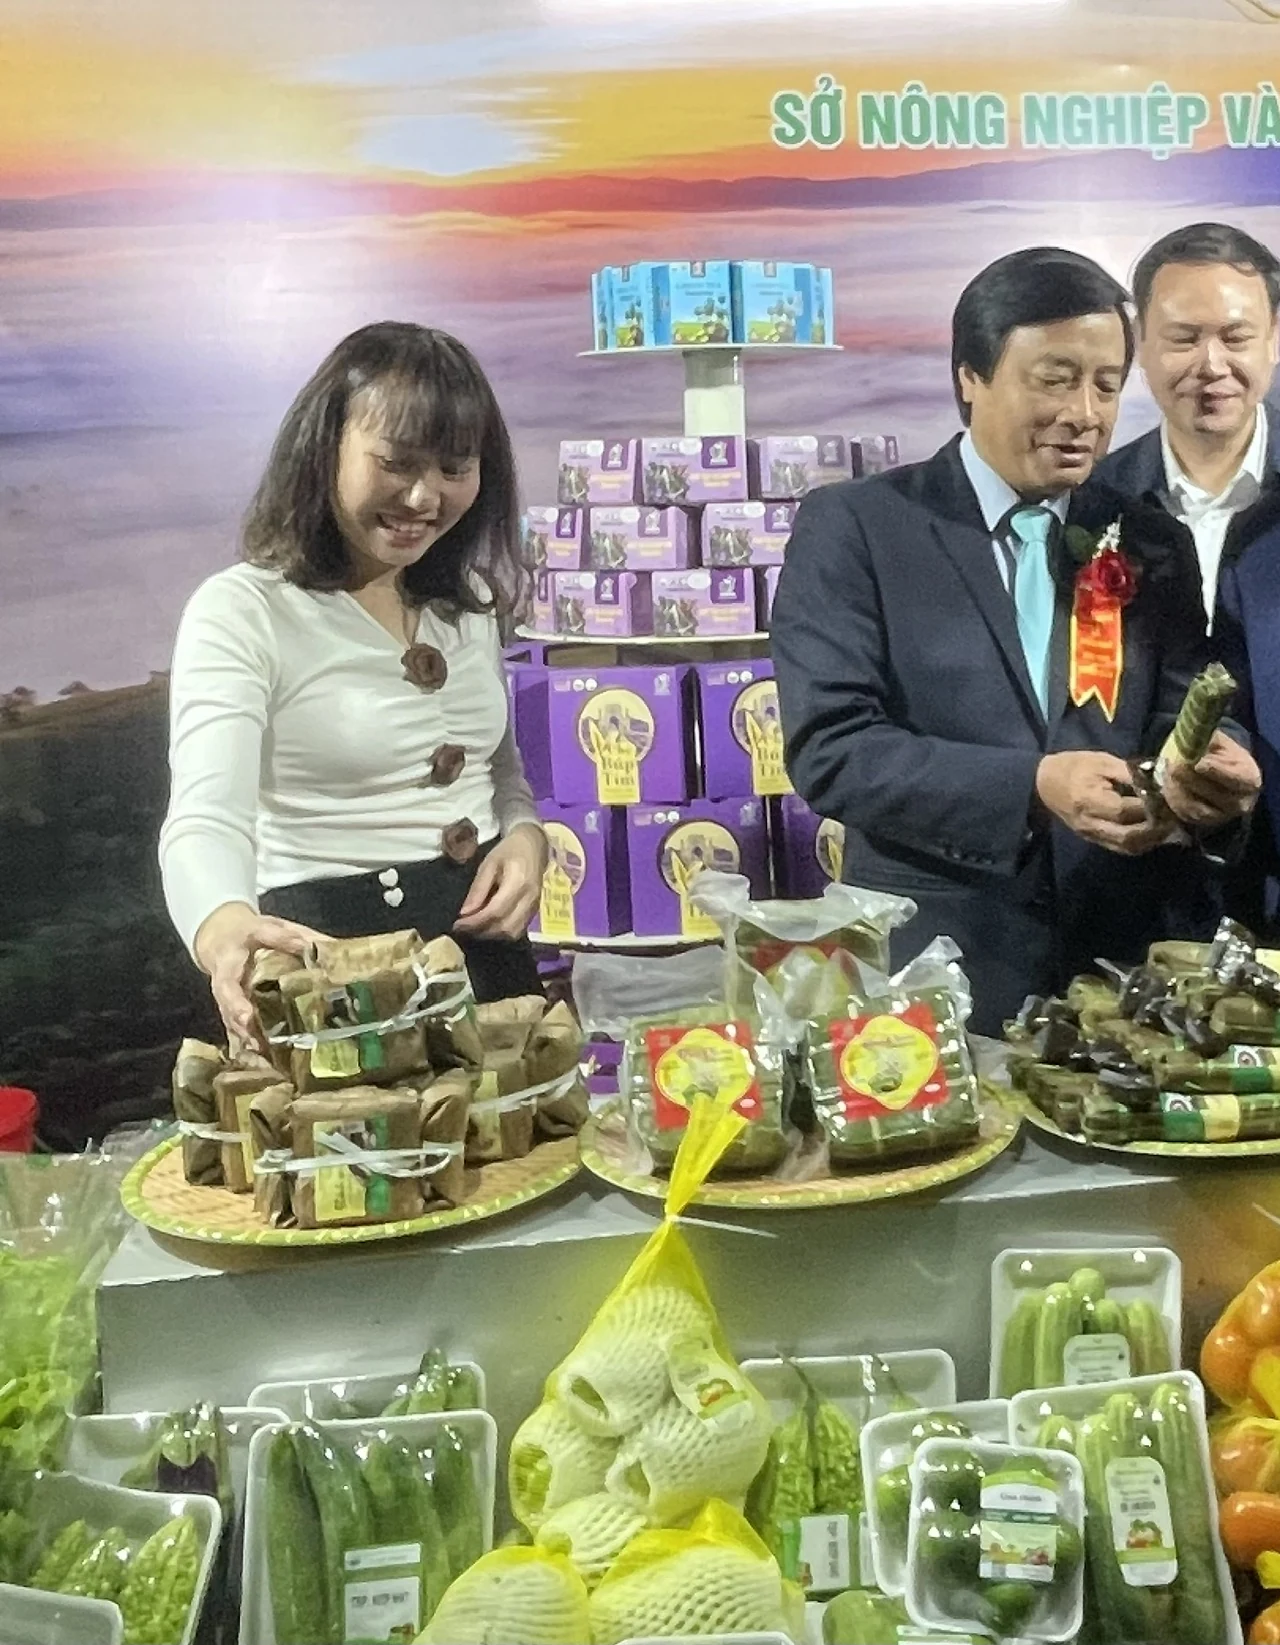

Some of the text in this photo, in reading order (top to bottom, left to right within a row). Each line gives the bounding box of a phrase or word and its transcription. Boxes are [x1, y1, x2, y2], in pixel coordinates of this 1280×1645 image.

[772, 76, 844, 146] SỞ
[859, 83, 1005, 147] NÔNG
[1022, 83, 1208, 158] NGHIỆP
